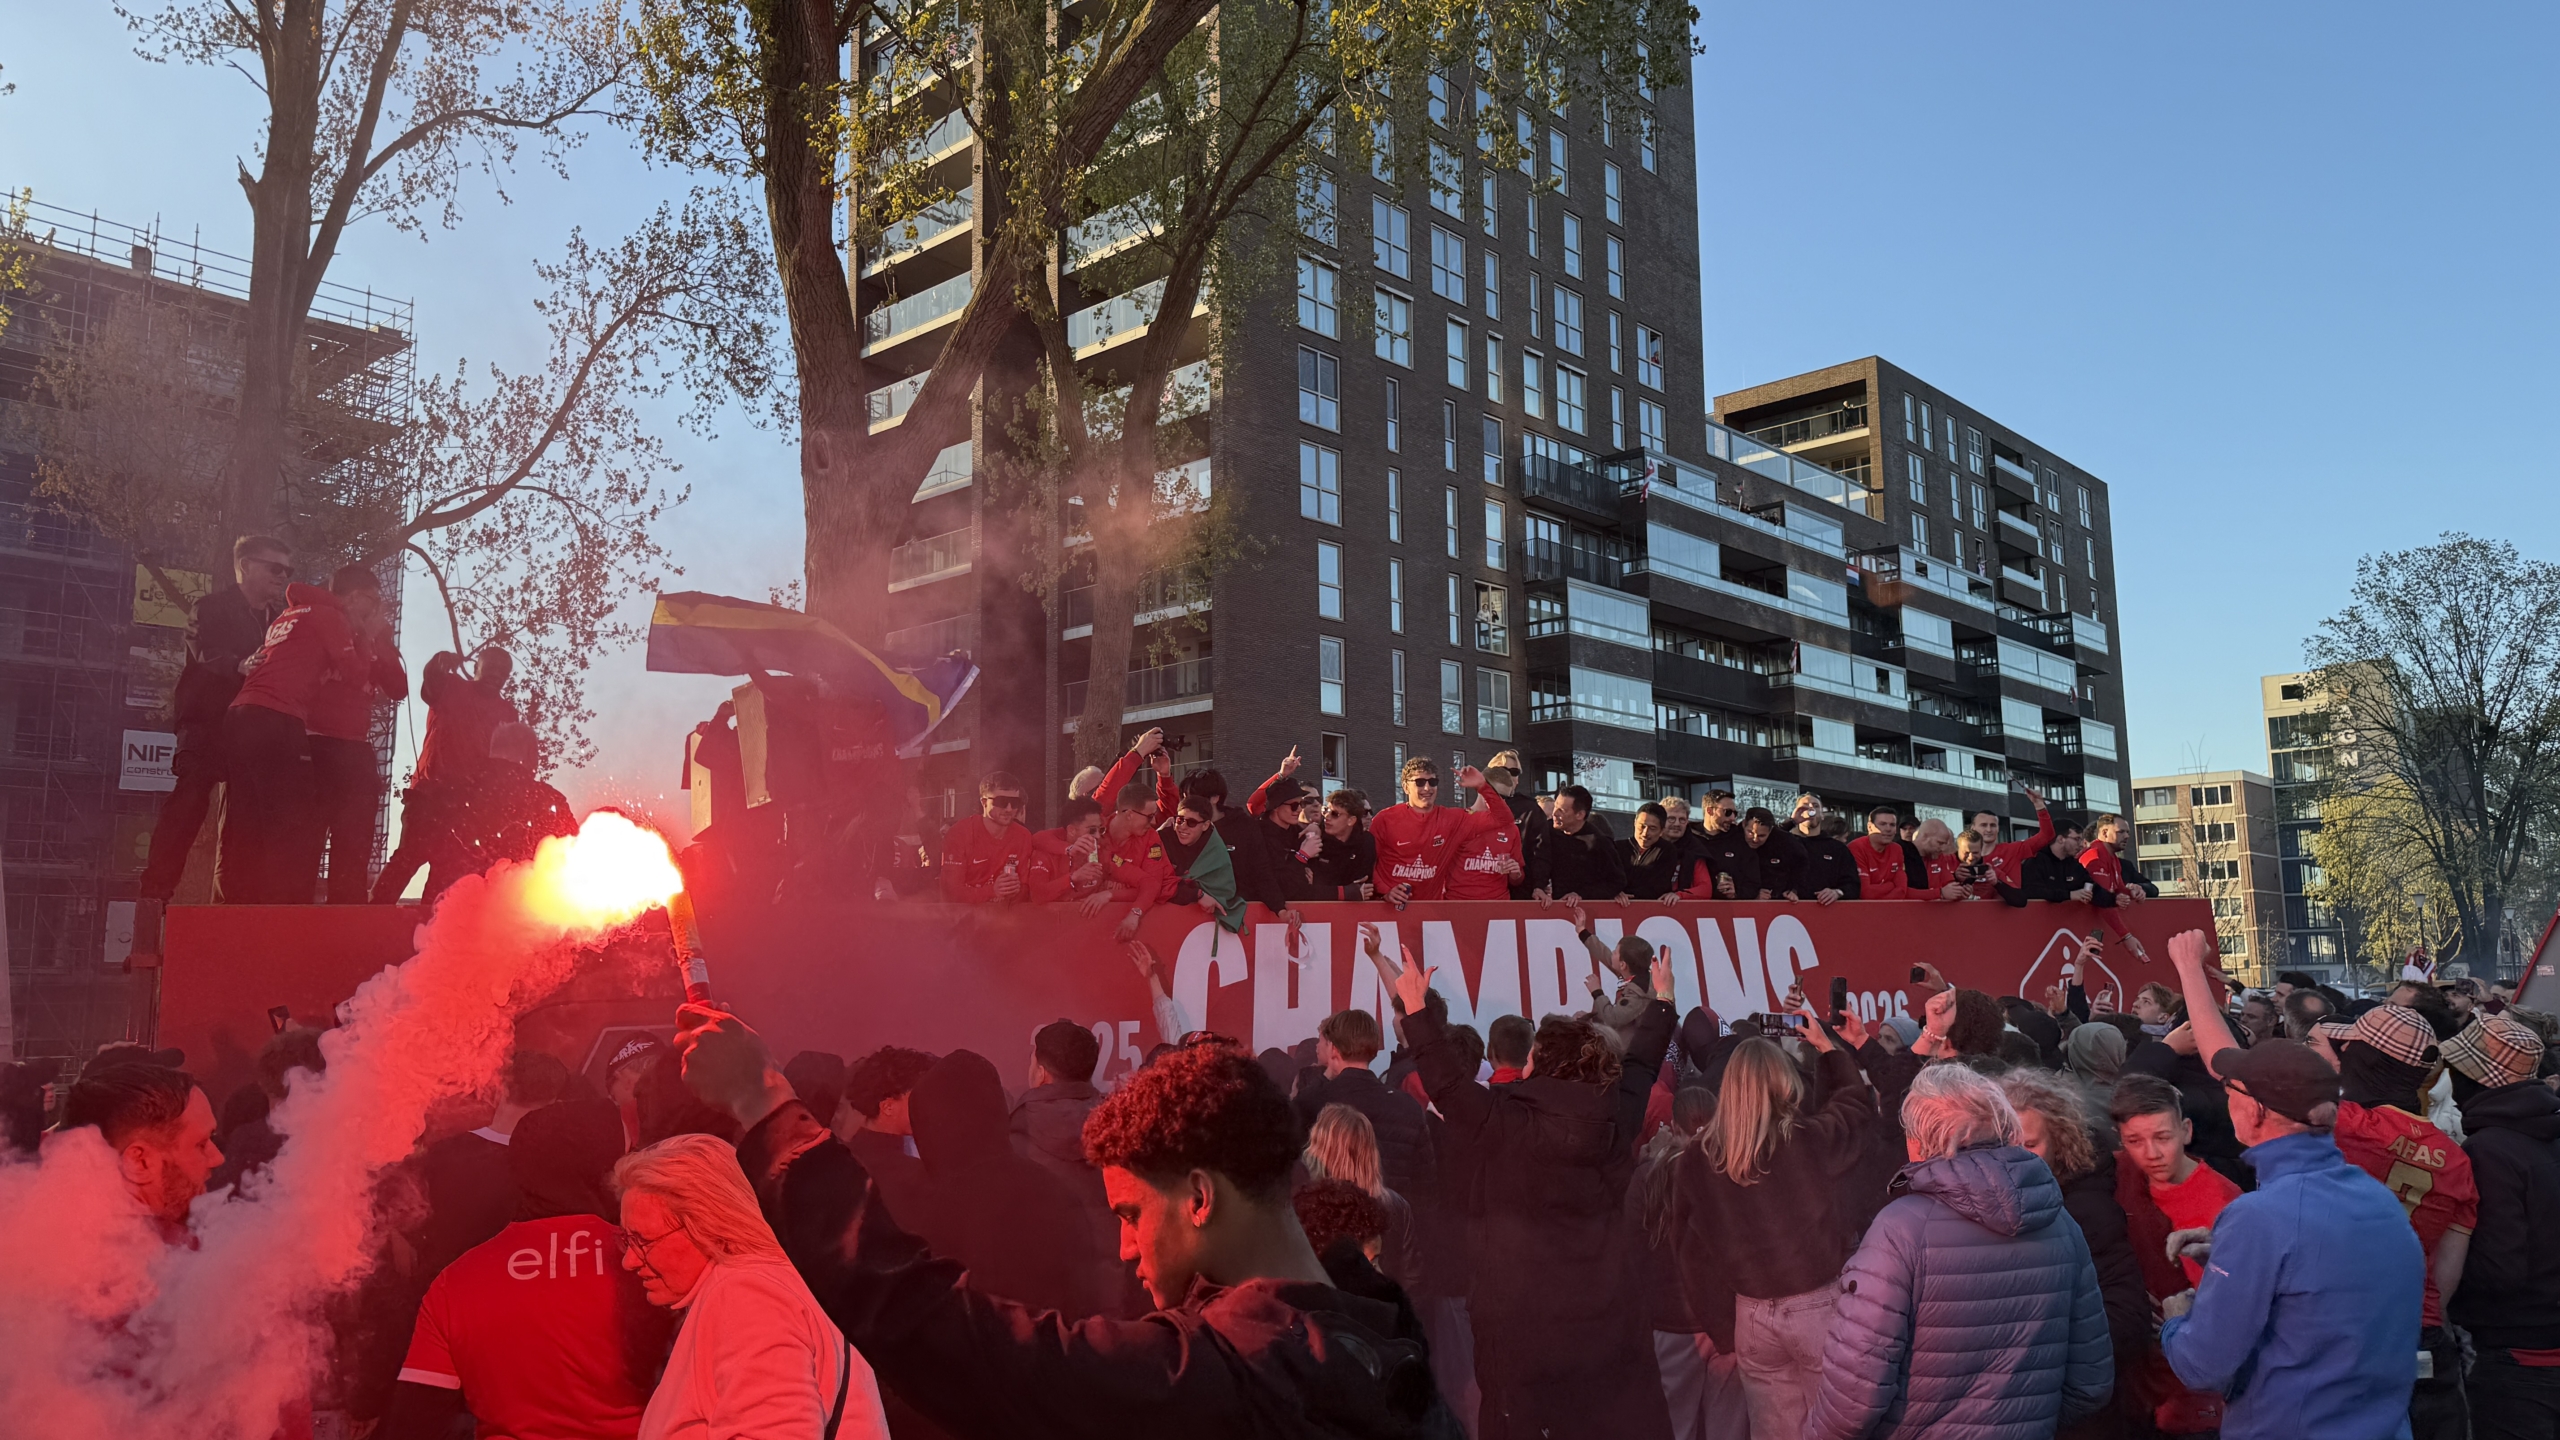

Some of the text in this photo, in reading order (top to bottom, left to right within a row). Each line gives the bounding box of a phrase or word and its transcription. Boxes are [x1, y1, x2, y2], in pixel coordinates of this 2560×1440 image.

[127, 743, 176, 763] NIF
[1392, 864, 1437, 880] CHAMPIONS
[2388, 1135, 2446, 1168] AFAS
[507, 1230, 604, 1280] elfi
